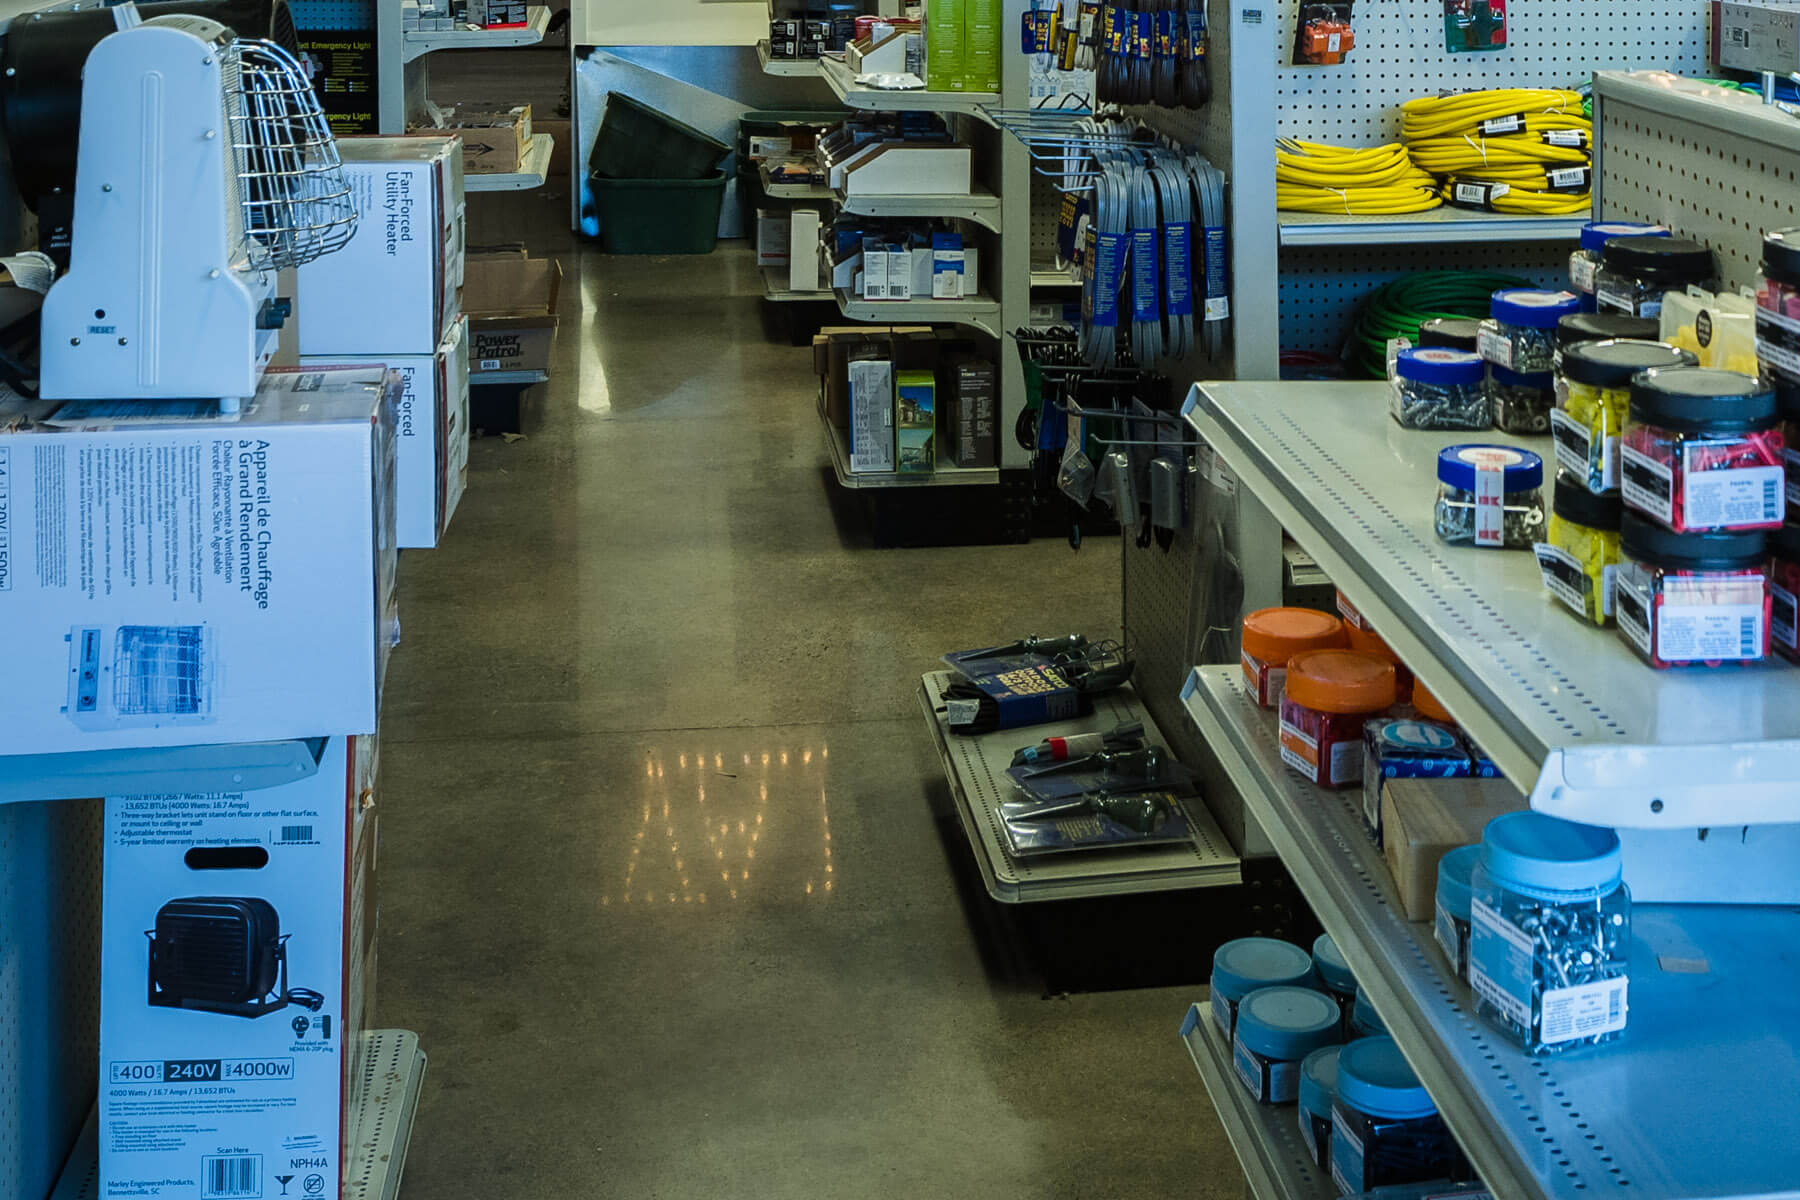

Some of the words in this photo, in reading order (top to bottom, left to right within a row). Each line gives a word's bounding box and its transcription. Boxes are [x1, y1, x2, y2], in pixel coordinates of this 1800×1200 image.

[312, 41, 352, 50] Emergency
[352, 41, 371, 51] Light
[352, 112, 371, 121] Light
[383, 171, 399, 211] Utility
[400, 171, 413, 241] Fan-Forced
[386, 214, 399, 257] Heater
[89, 326, 116, 334] RESET
[475, 333, 520, 347] Power
[476, 344, 520, 359] Patrol
[402, 367, 415, 437] Fan-Forced
[212, 440, 222, 471] Forcée
[239, 439, 251, 449] à
[223, 440, 233, 475] Chaleur
[239, 451, 253, 500] Grand
[255, 439, 272, 505] Appareil
[222, 475, 233, 525] Rayonnante
[257, 508, 272, 525] de
[210, 536, 222, 576] Agréable
[223, 533, 233, 584] Ventilation
[239, 502, 253, 593] Rendement
[253, 526, 272, 610] Chauffage
[156, 811, 180, 819] bracket
[119, 1064, 155, 1079] 400
[169, 1063, 218, 1079] 240V
[232, 1061, 290, 1077] 4000w
[109, 1089, 127, 1097] 4000
[128, 1088, 147, 1096] Watts
[169, 1088, 188, 1097] Amps
[218, 1087, 236, 1095] BTUs
[233, 1146, 249, 1154] Here
[289, 1158, 328, 1169] NPH4A
[107, 1179, 129, 1189] Marley
